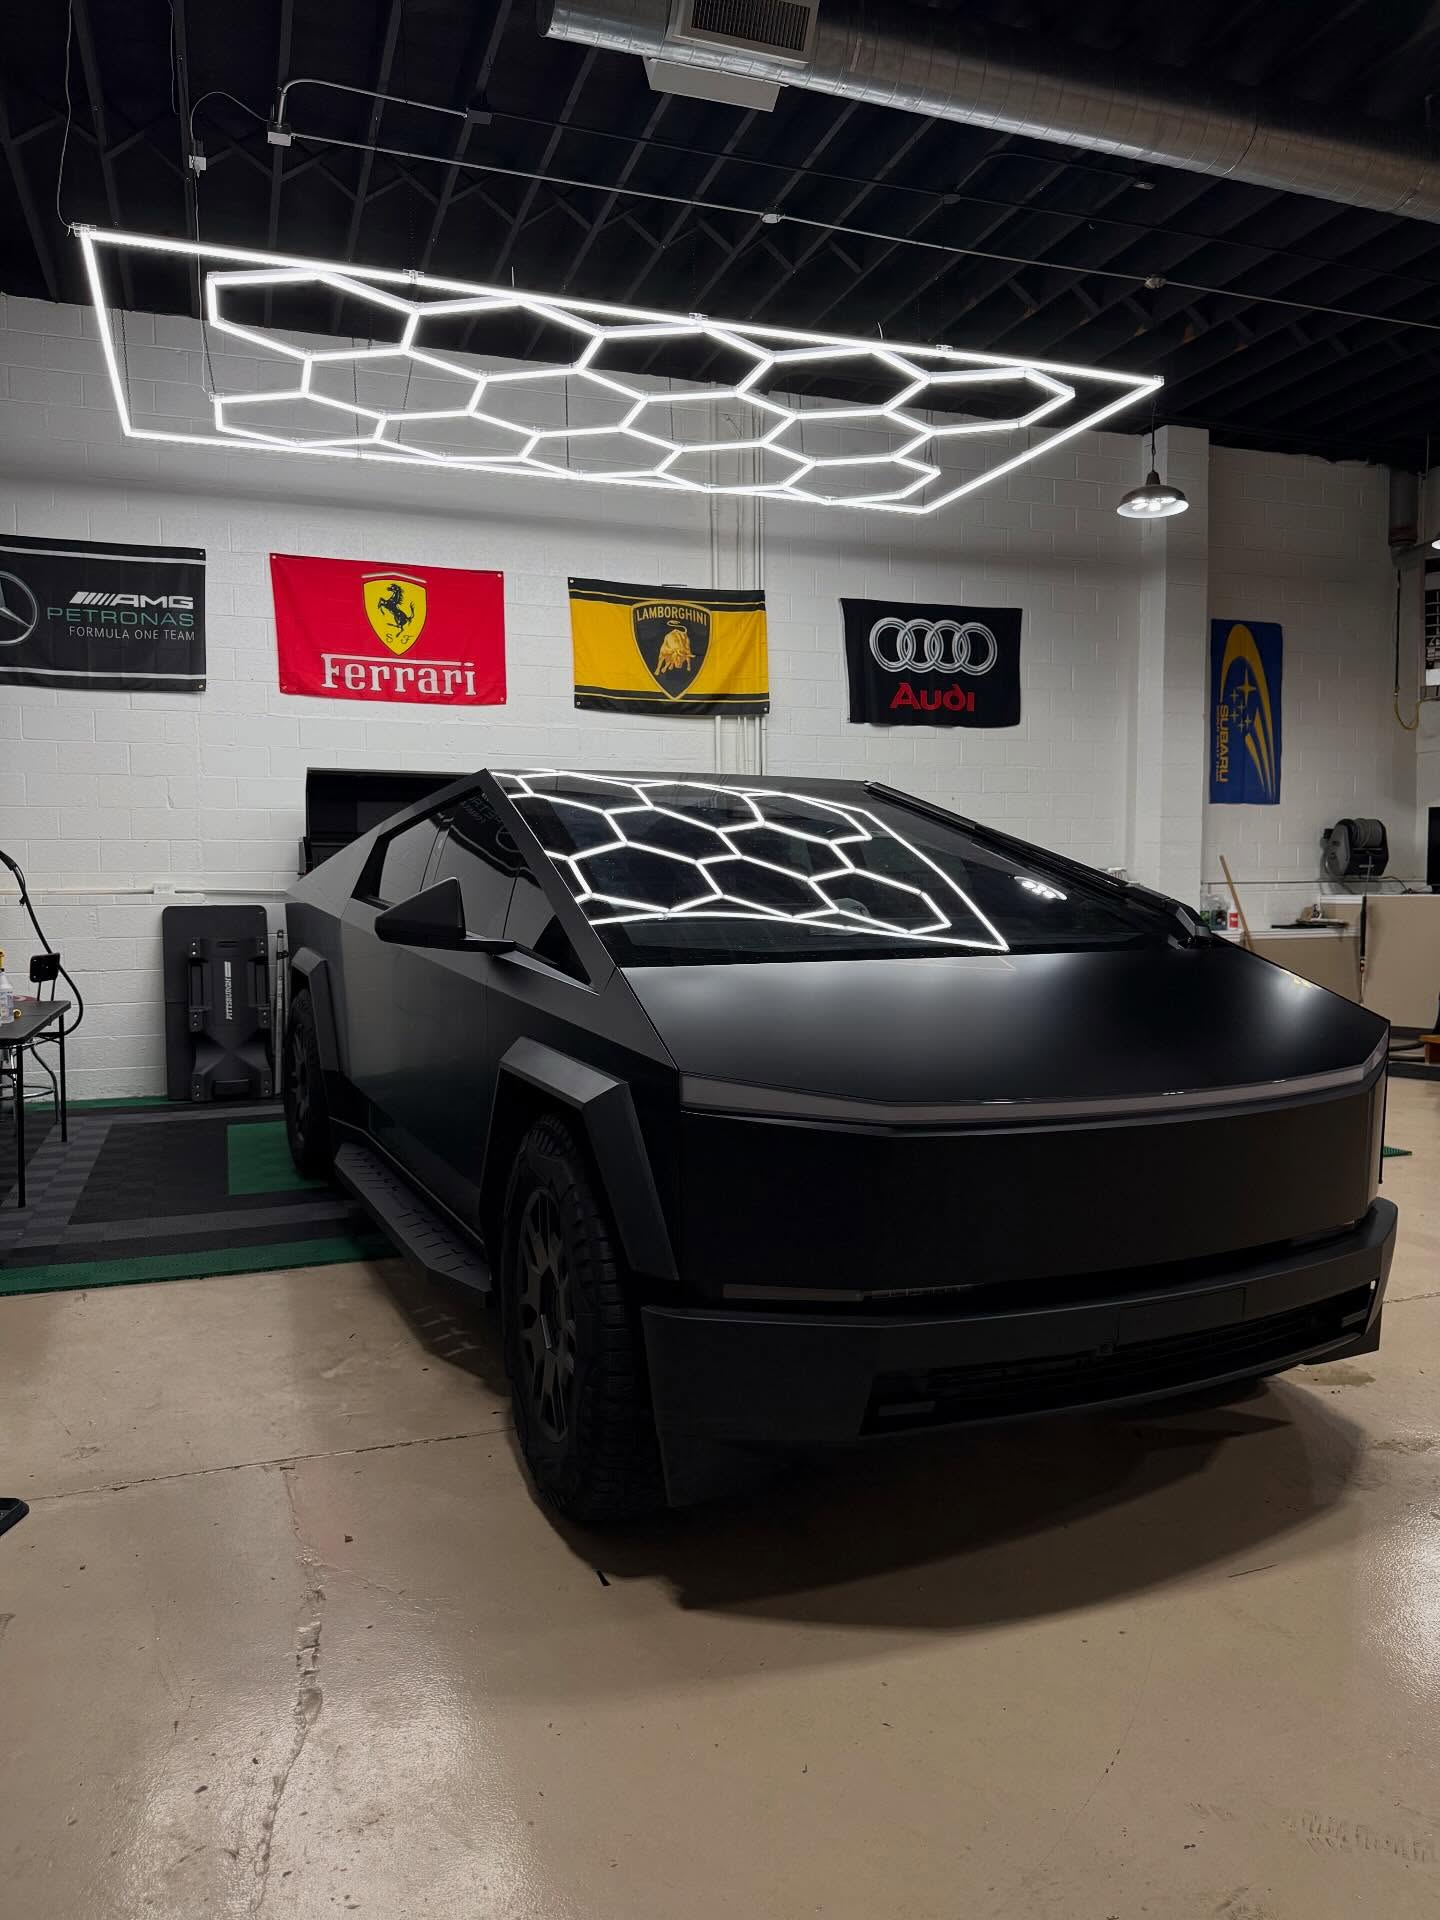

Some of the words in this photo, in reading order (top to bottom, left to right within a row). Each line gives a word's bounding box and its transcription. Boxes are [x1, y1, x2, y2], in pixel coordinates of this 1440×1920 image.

[109, 593, 194, 609] AMG
[47, 607, 194, 627] PETRONAS
[636, 606, 707, 626] LAMBORGHINI
[69, 626, 130, 639] FORMULA
[134, 629, 159, 640] ONE
[164, 629, 195, 641] TEAM
[320, 653, 477, 696] Ferrari
[888, 682, 975, 712] Audi
[1219, 704, 1229, 783] SUBARU
